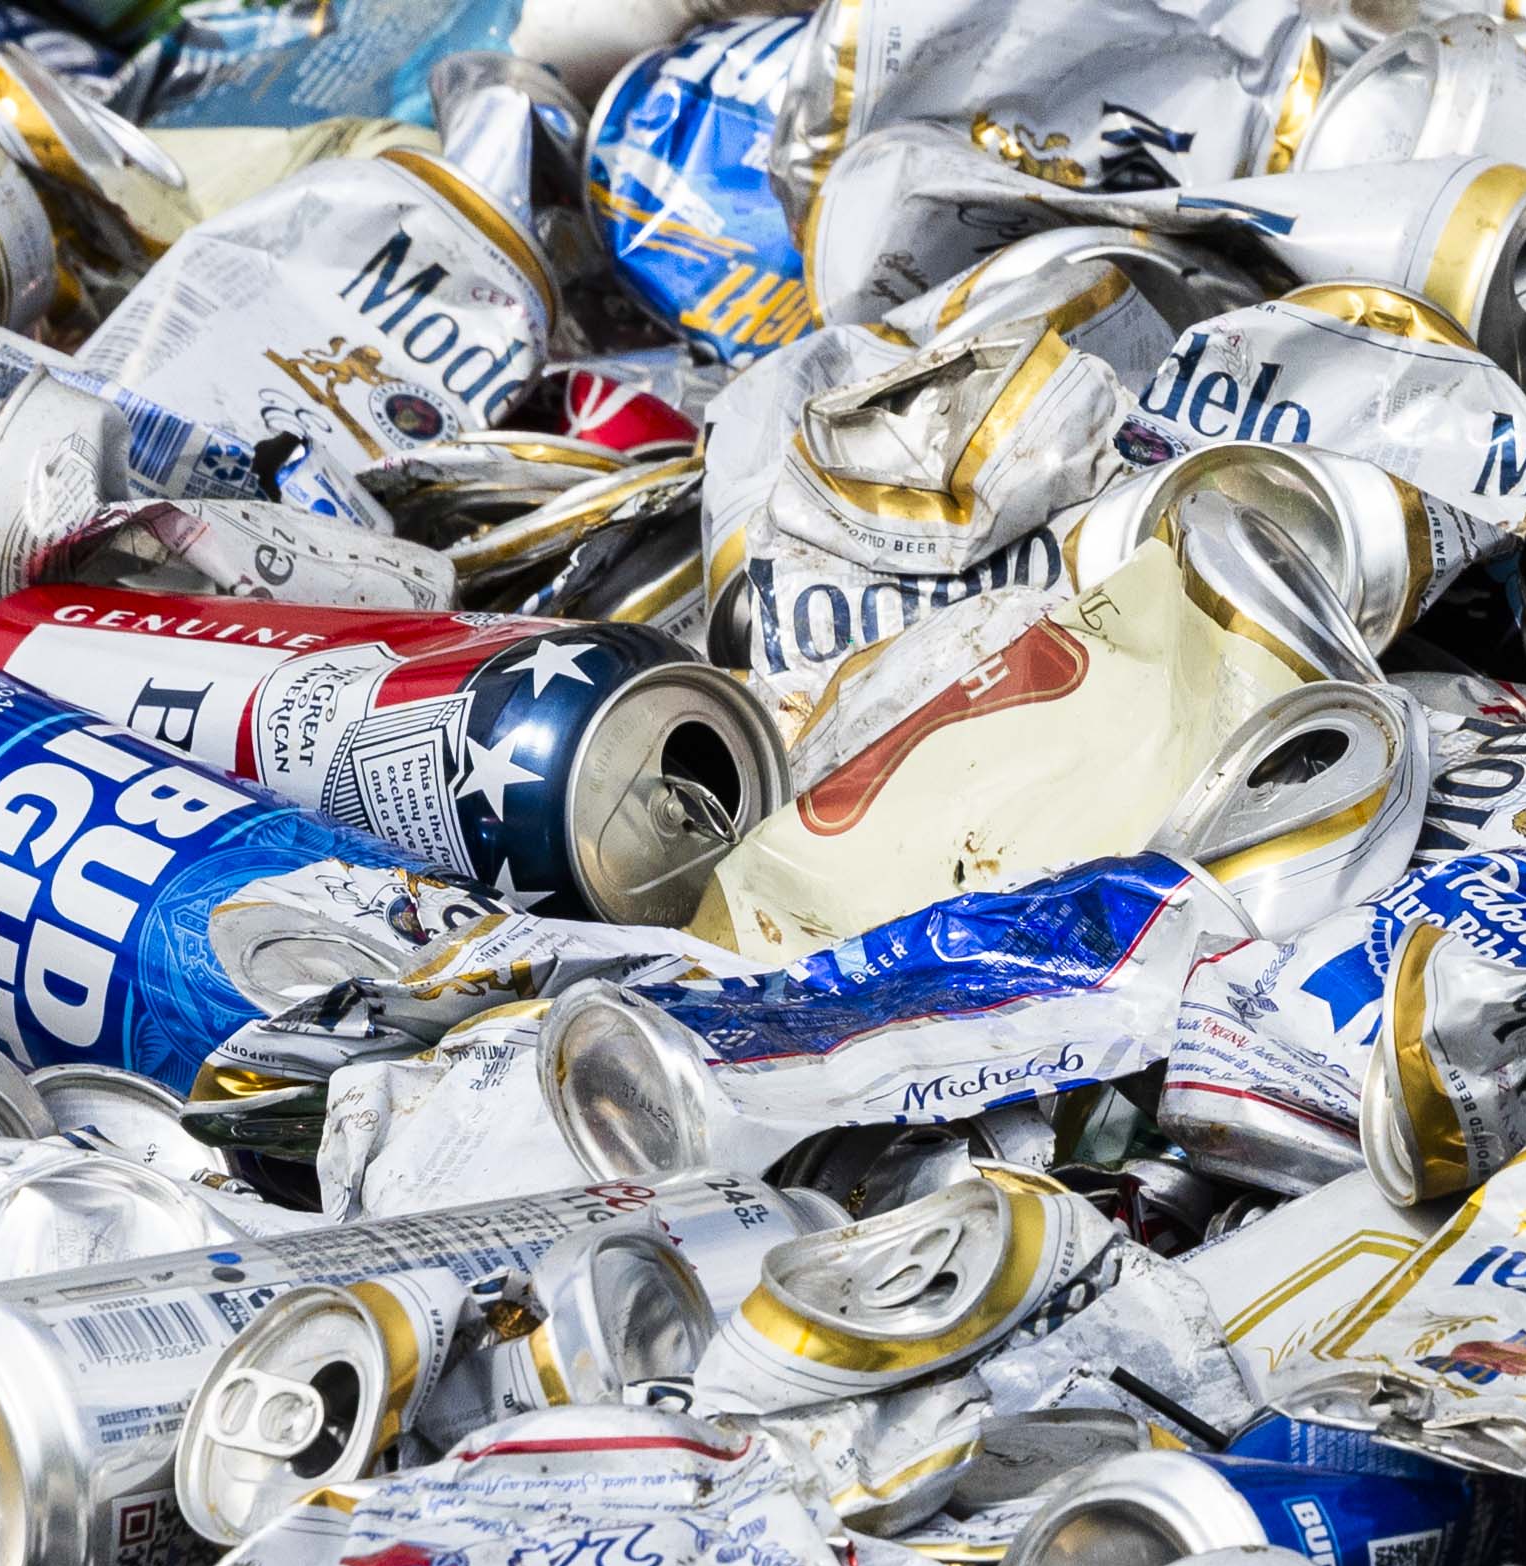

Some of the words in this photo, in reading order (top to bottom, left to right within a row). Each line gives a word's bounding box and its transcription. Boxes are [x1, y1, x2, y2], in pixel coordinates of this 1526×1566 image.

[893, 538, 940, 557] BEER
[53, 603, 327, 651] GENUINE
[268, 662, 333, 774] AMERICAN
[298, 675, 338, 768] GREAT
[371, 769, 385, 805] and
[402, 760, 414, 779] by
[386, 765, 416, 850] exclusive
[405, 791, 421, 822] any
[417, 752, 432, 787] This
[428, 813, 443, 843] the
[27, 753, 256, 1048] BUD
[850, 941, 909, 988] BEER
[874, 1044, 1085, 1113] Michelob
[1449, 1068, 1479, 1113] BEER
[706, 1176, 754, 1210] 24
[750, 1202, 771, 1225] FL
[732, 1206, 756, 1232] OZ
[429, 1308, 441, 1345] BEER
[101, 1350, 151, 1367] 71990
[154, 1342, 202, 1361] 30065
